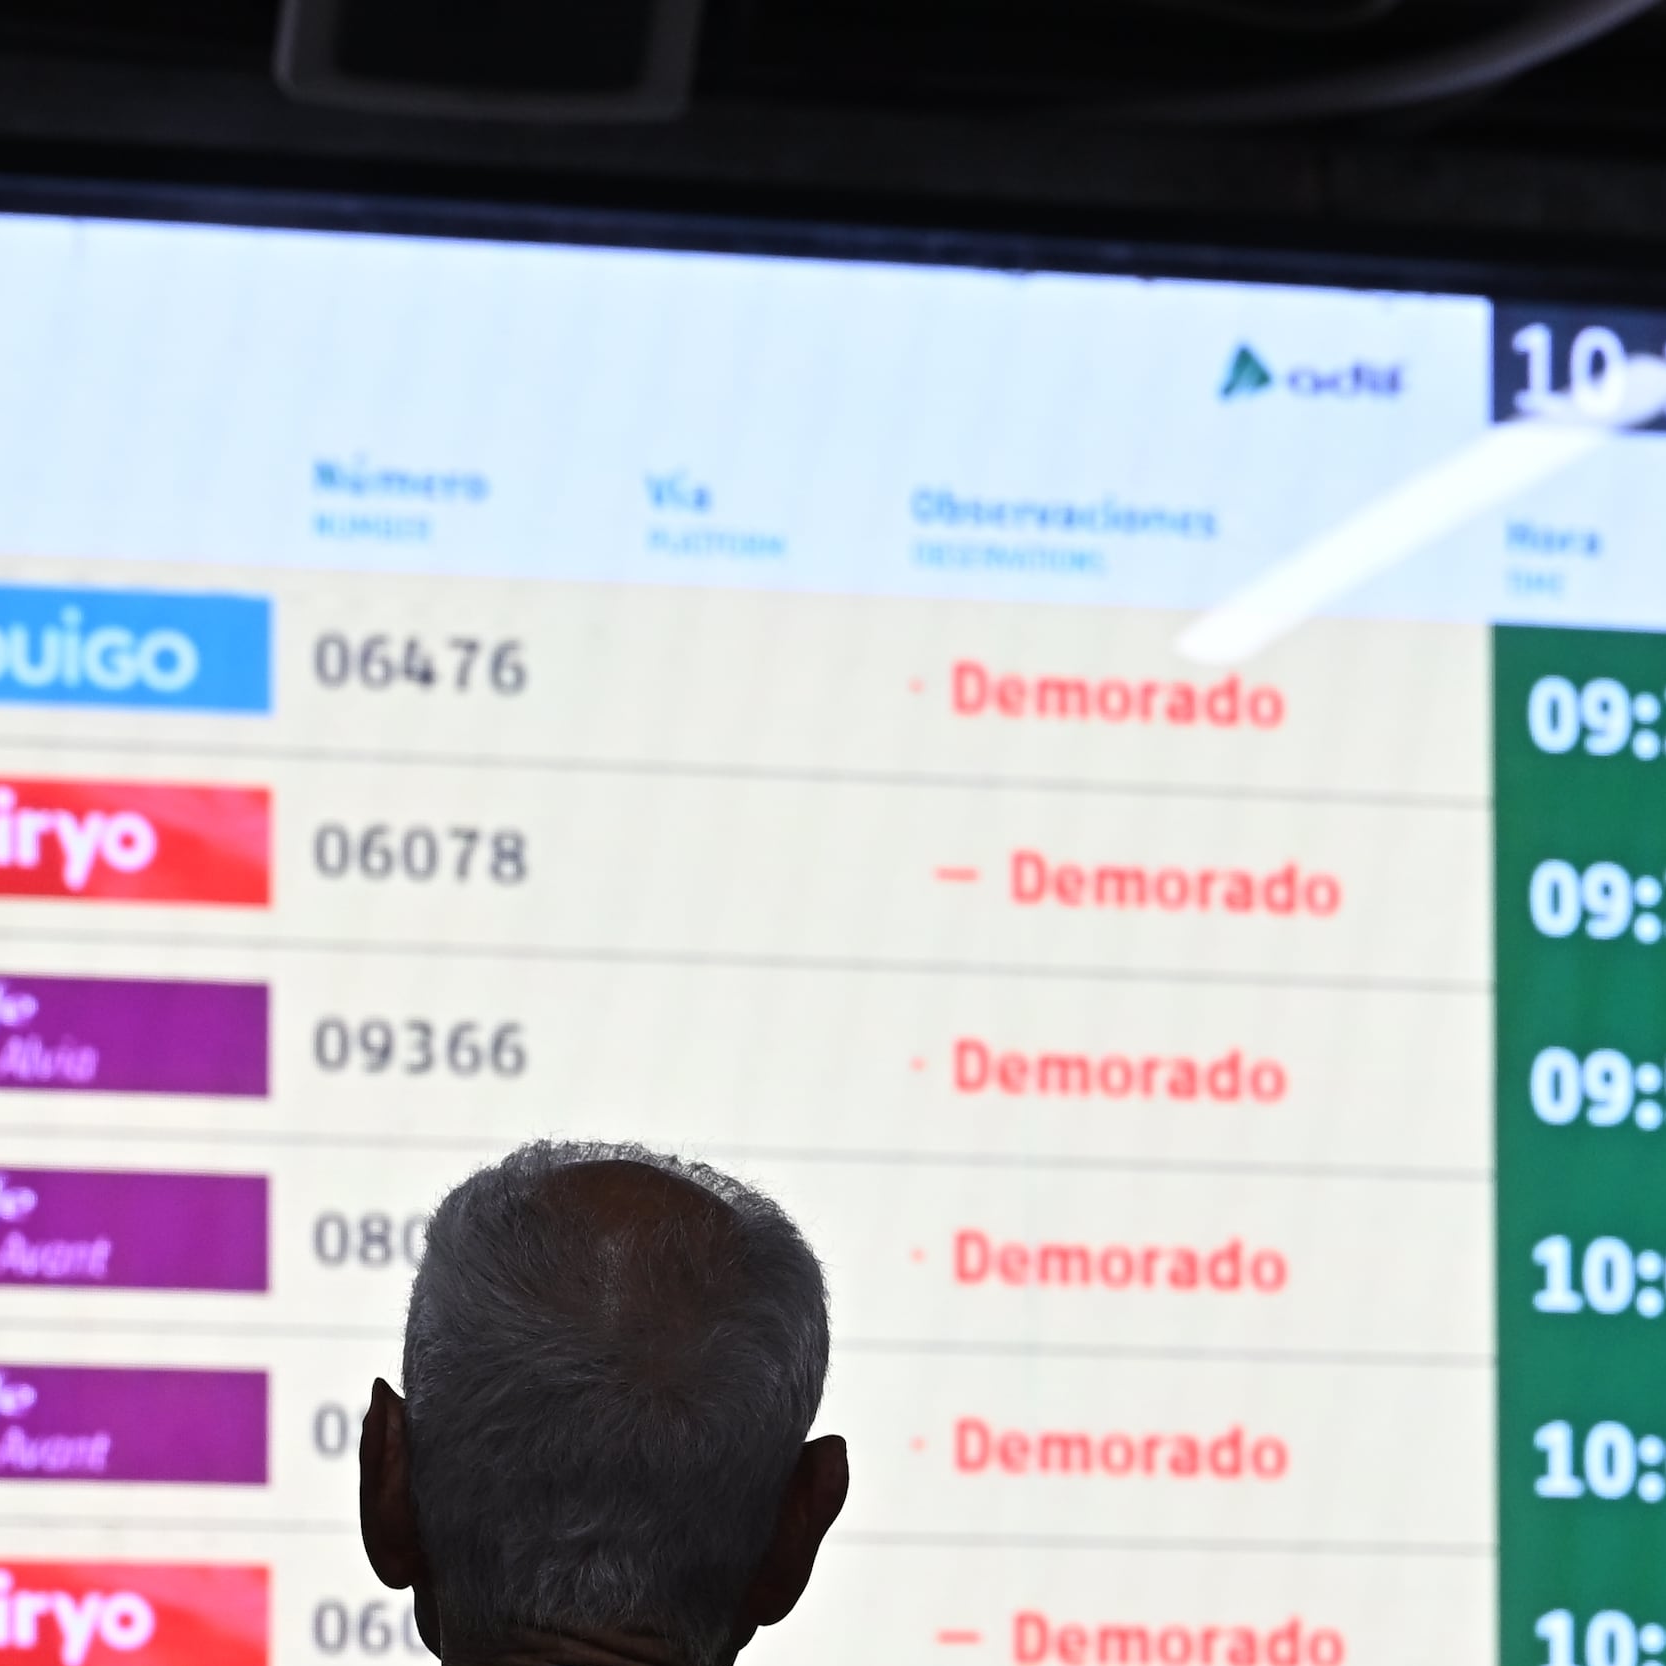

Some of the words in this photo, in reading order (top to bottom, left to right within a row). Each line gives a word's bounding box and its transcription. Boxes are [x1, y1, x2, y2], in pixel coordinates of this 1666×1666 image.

[312, 631, 529, 697] 06476
[950, 658, 1287, 730] Demorado
[312, 822, 530, 886] 06078
[1009, 847, 1343, 918] Demorado
[311, 1016, 529, 1079] 09366
[951, 1036, 1289, 1105] Demorado
[952, 1227, 1290, 1295] Demorado
[953, 1415, 1290, 1482] Demorado
